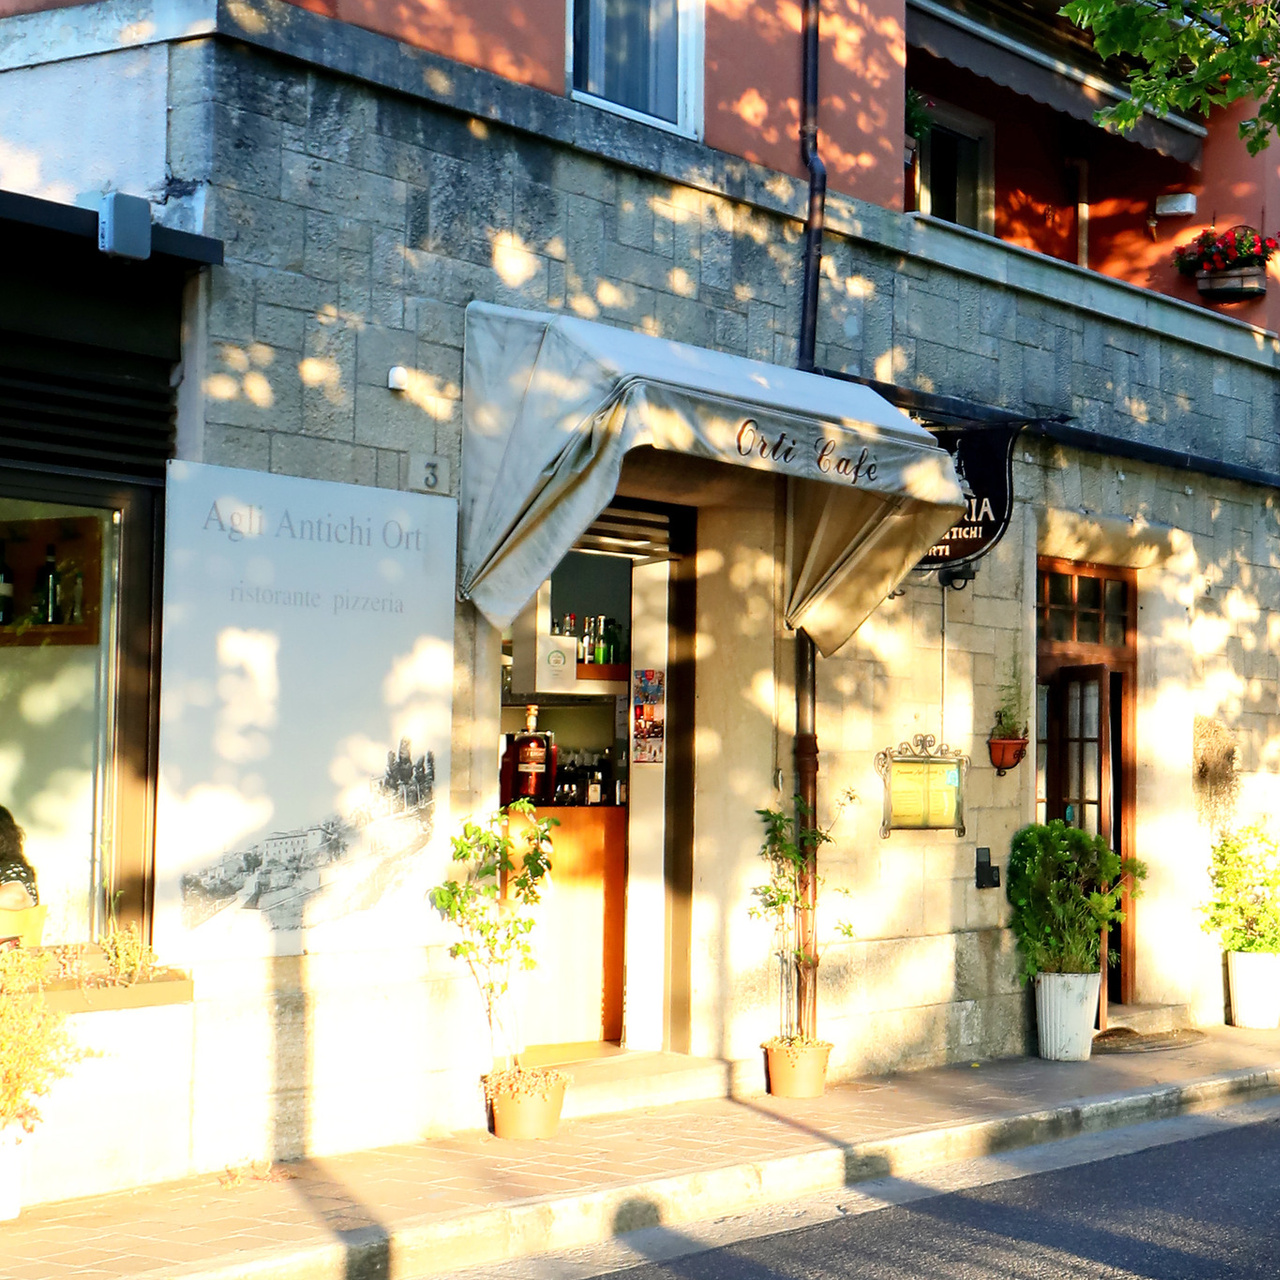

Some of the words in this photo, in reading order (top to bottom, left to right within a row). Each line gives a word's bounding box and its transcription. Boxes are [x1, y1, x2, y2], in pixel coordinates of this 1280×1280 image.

[737, 419, 797, 464] Orti
[423, 462, 439, 489] 3
[203, 499, 265, 543] Agli
[275, 508, 372, 548] Antichi
[926, 544, 950, 557] RTI
[230, 580, 321, 609] ristorante
[333, 587, 405, 615] pizzeria
